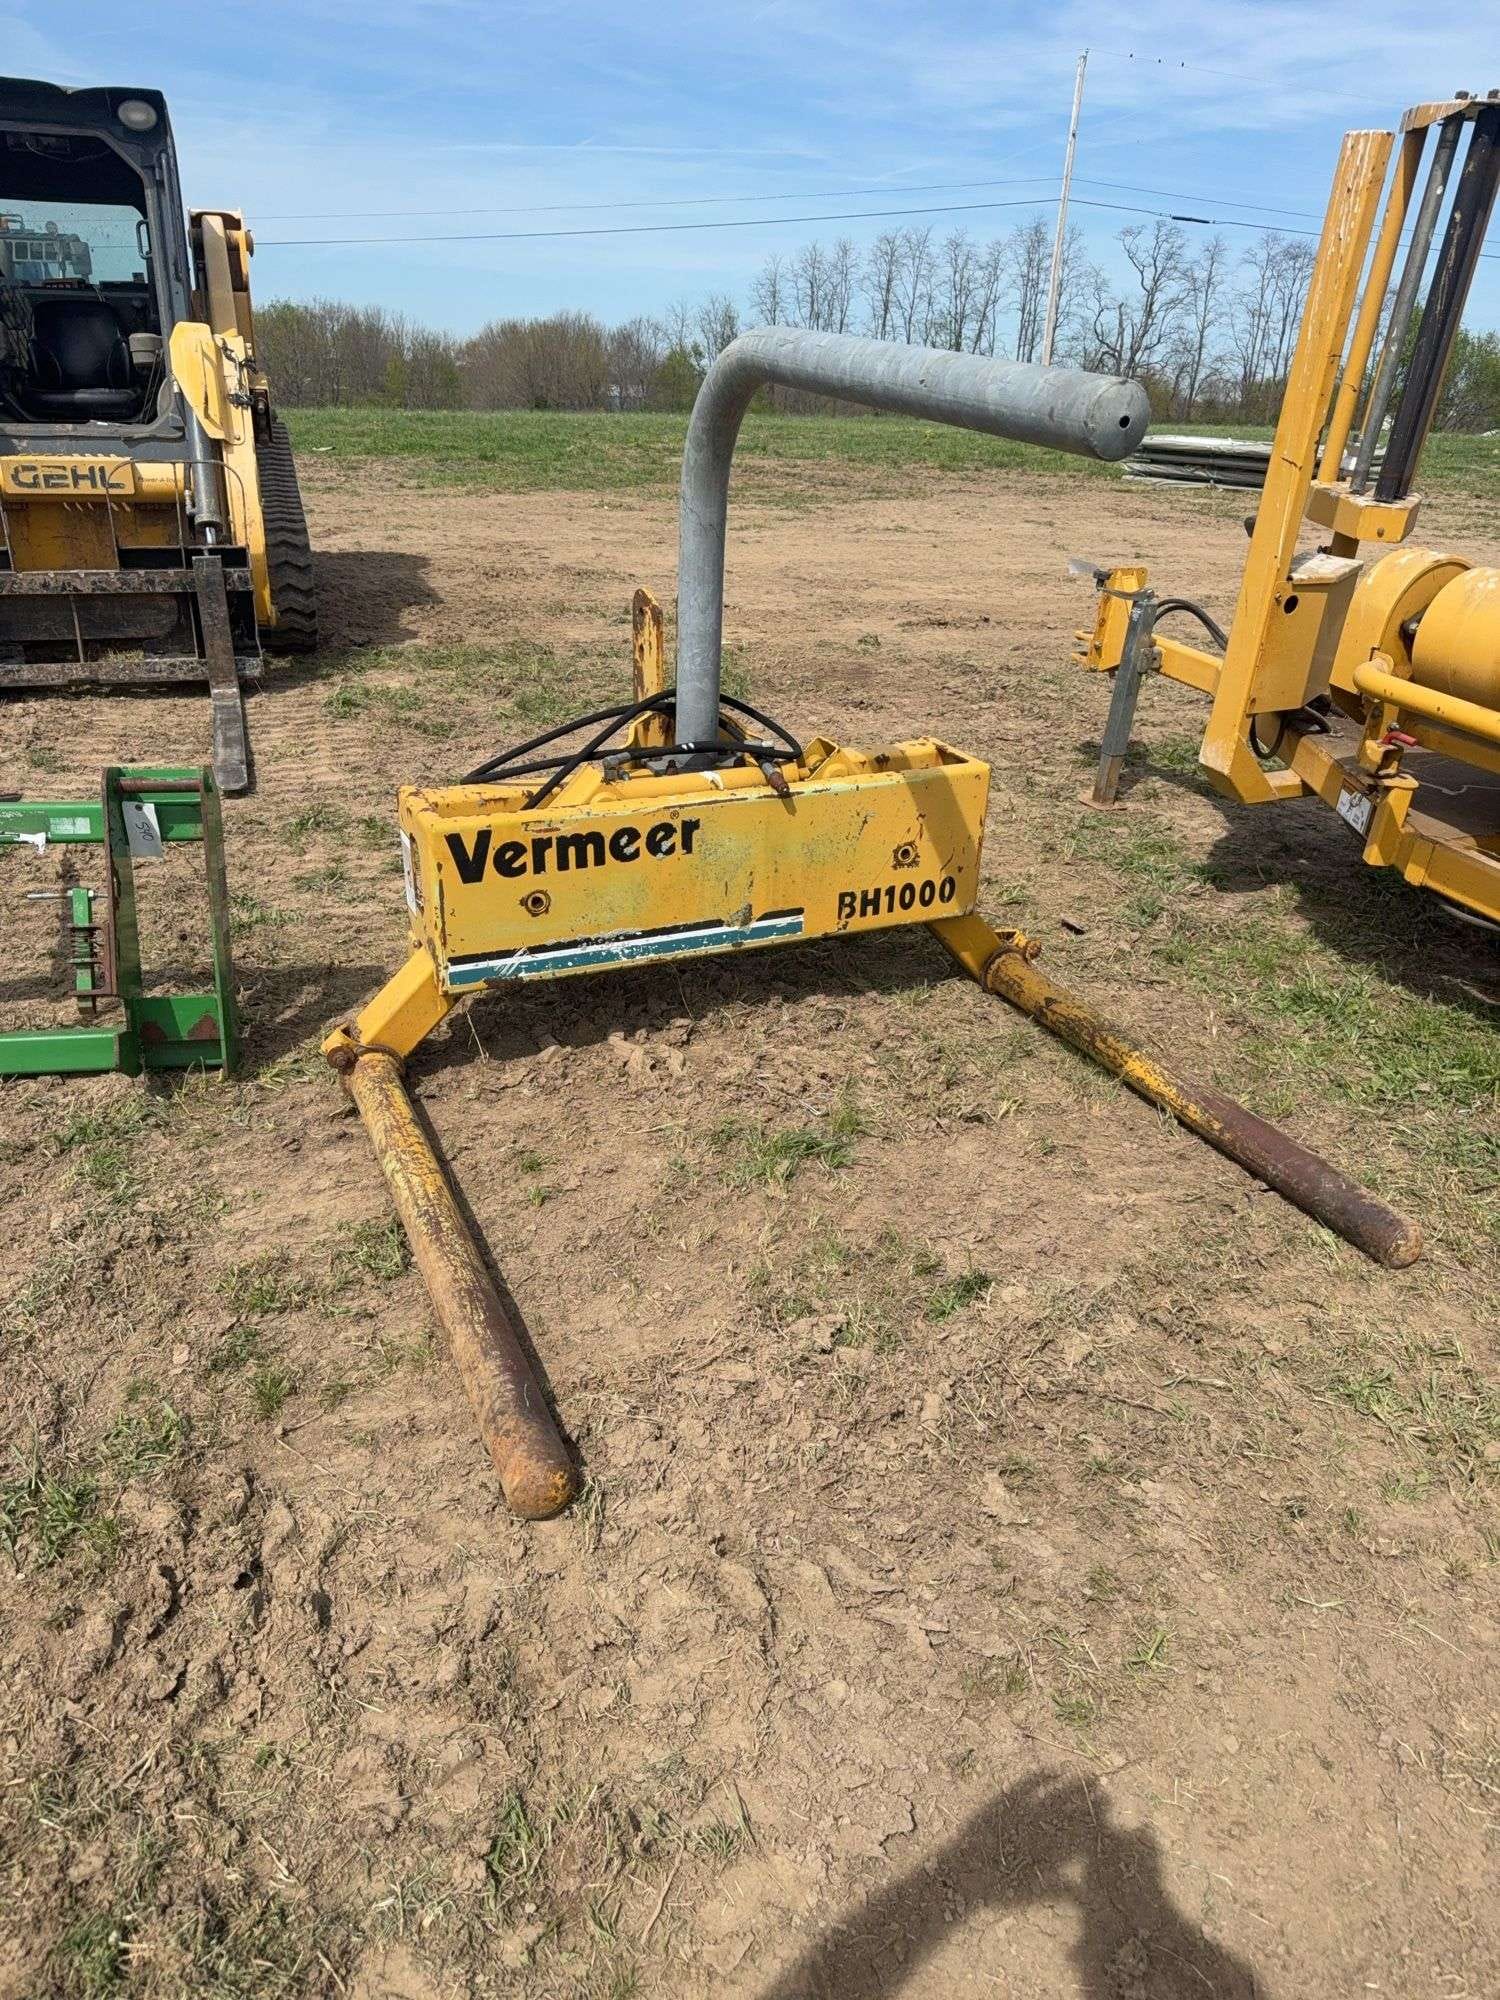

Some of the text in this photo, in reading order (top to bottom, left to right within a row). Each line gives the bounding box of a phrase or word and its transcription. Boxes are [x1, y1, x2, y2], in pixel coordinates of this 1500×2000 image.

[11, 464, 126, 489] GEHL
[444, 817, 701, 885] Vermeer
[837, 875, 956, 921] BH1000
